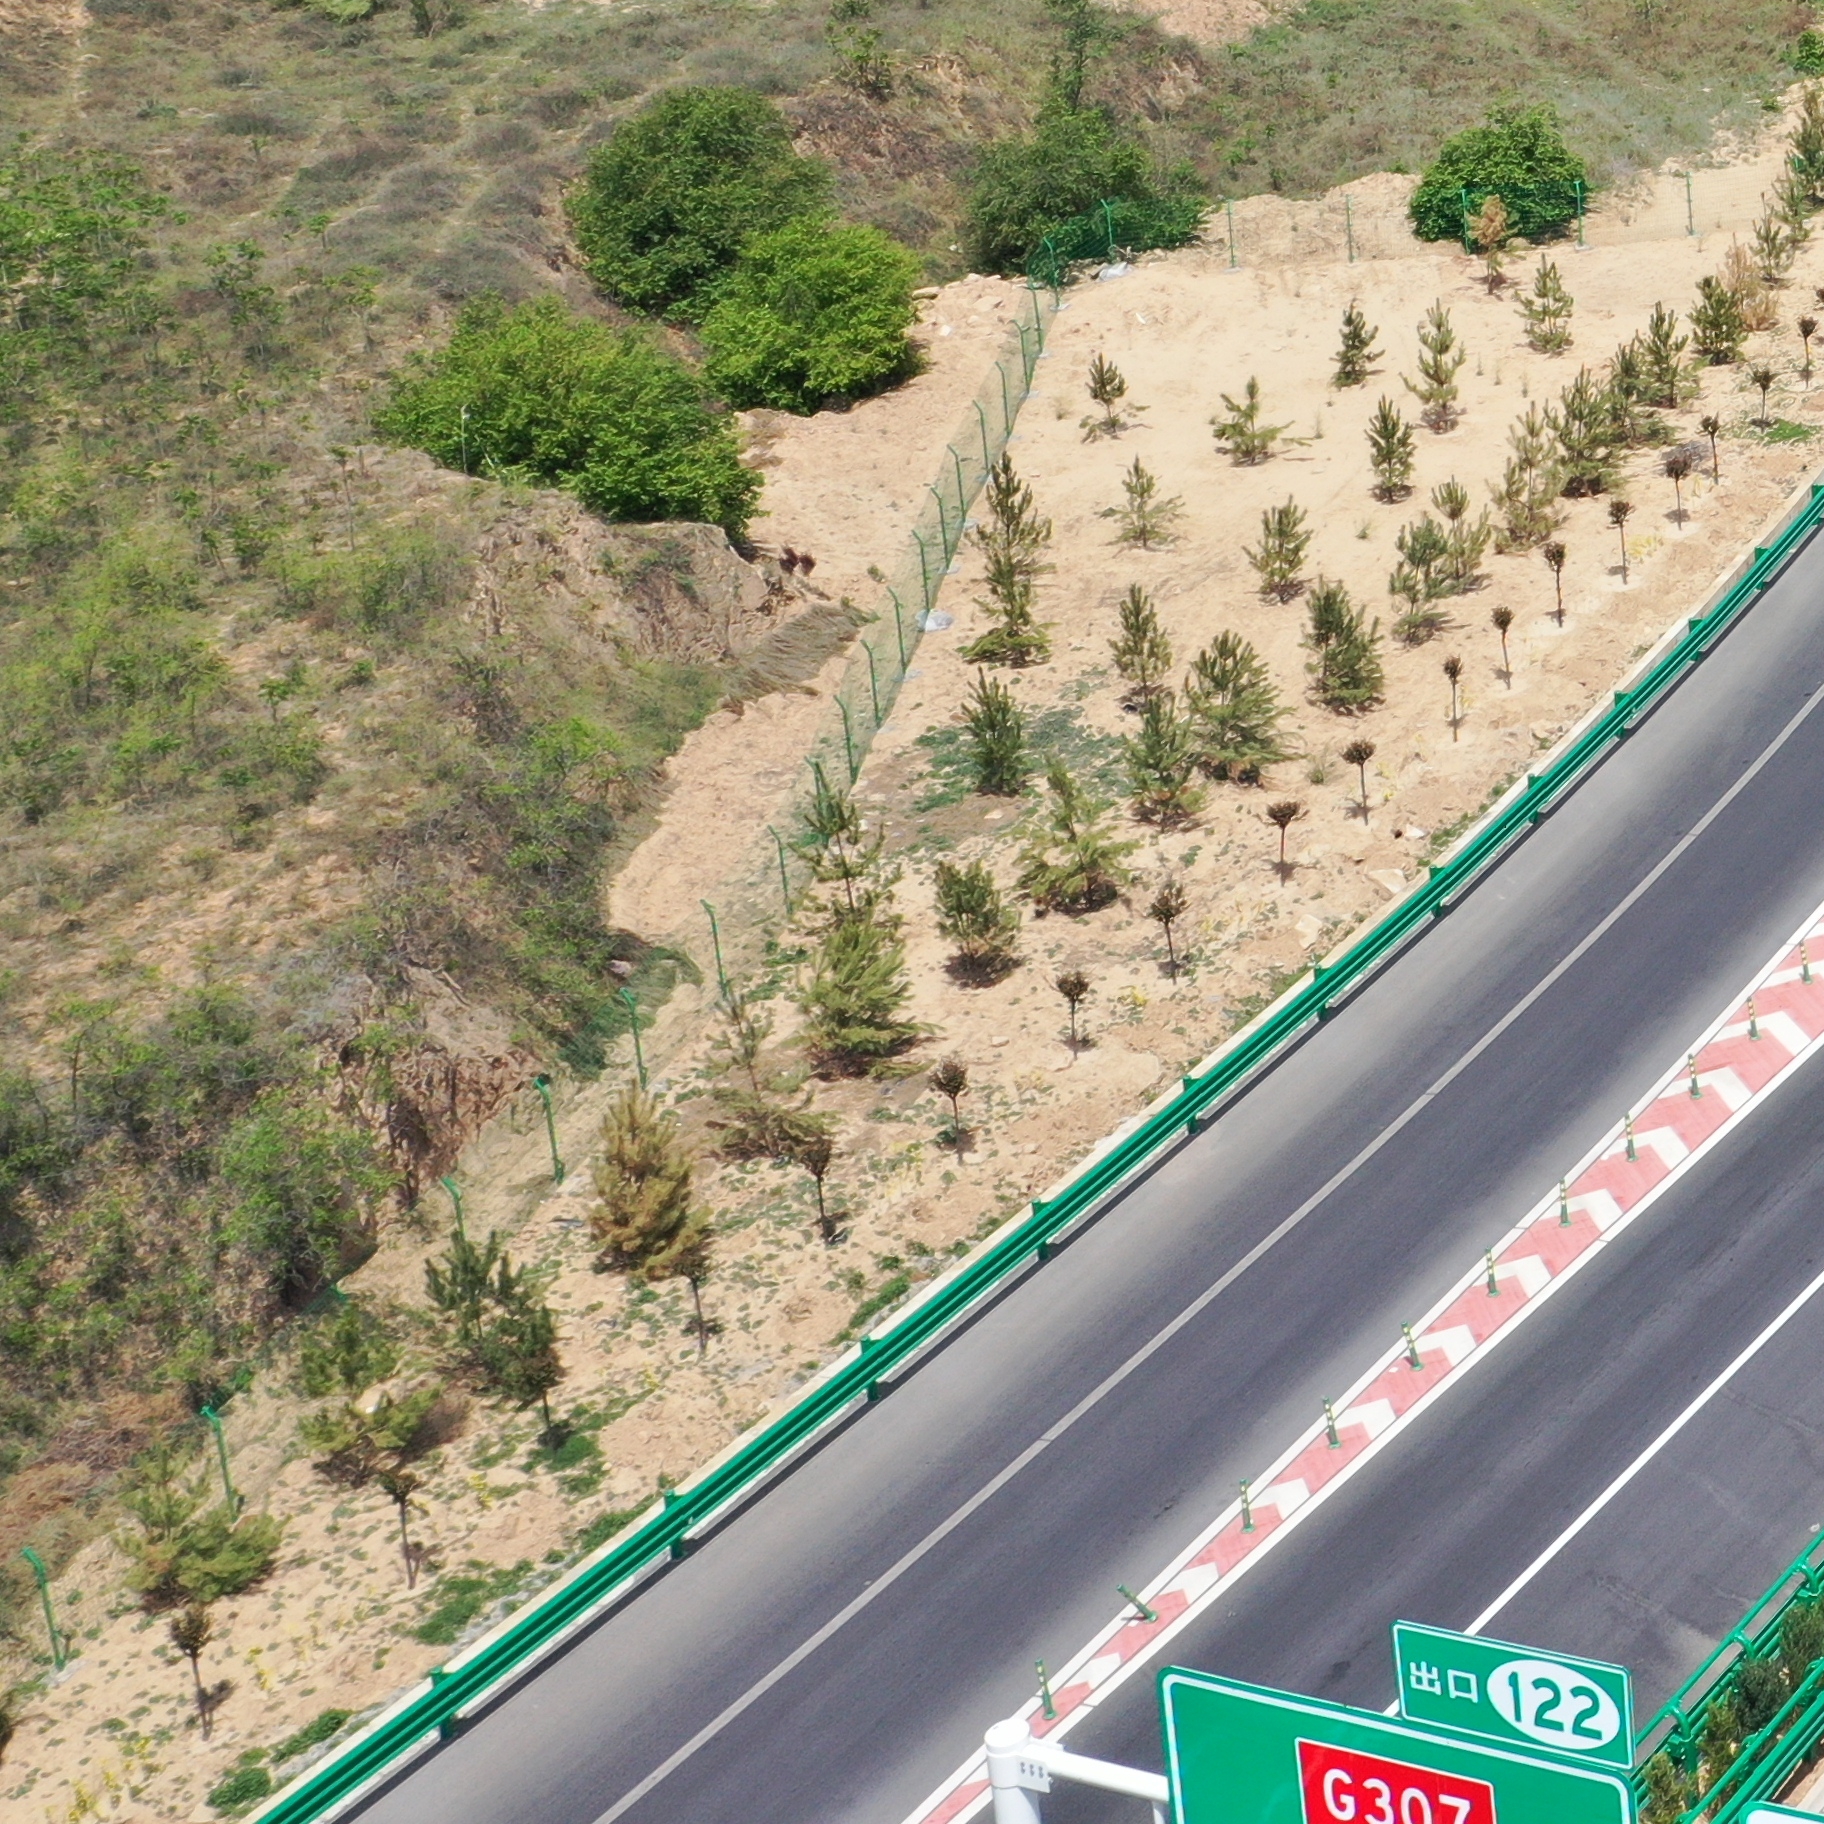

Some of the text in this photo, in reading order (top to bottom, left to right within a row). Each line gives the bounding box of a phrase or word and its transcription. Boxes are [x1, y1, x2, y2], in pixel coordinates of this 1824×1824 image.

[1410, 1660, 1603, 1741] 出口 122
[1323, 1768, 1471, 1824] G307
